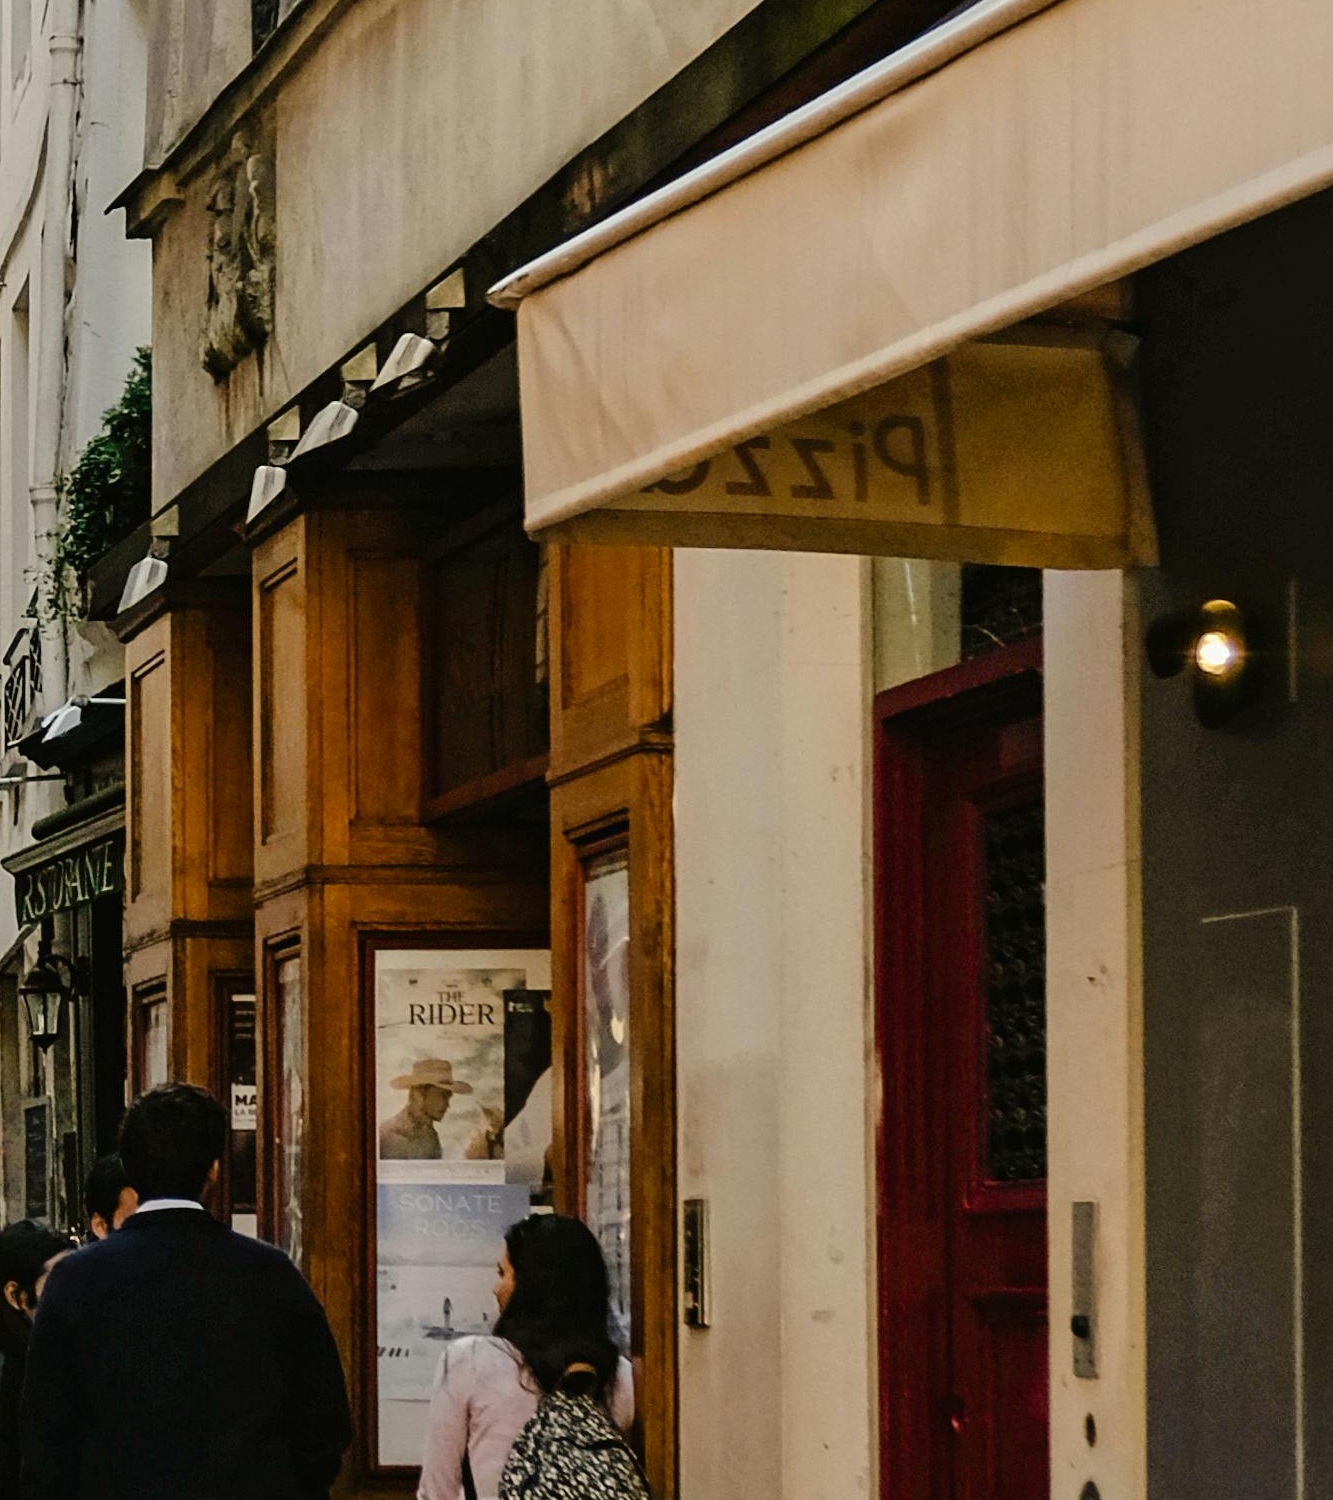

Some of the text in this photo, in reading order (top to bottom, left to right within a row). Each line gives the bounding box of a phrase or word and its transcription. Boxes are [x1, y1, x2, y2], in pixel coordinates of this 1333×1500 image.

[436, 990, 466, 1003] THE
[408, 1003, 495, 1025] RIDER
[398, 1194, 503, 1214] SONATE
